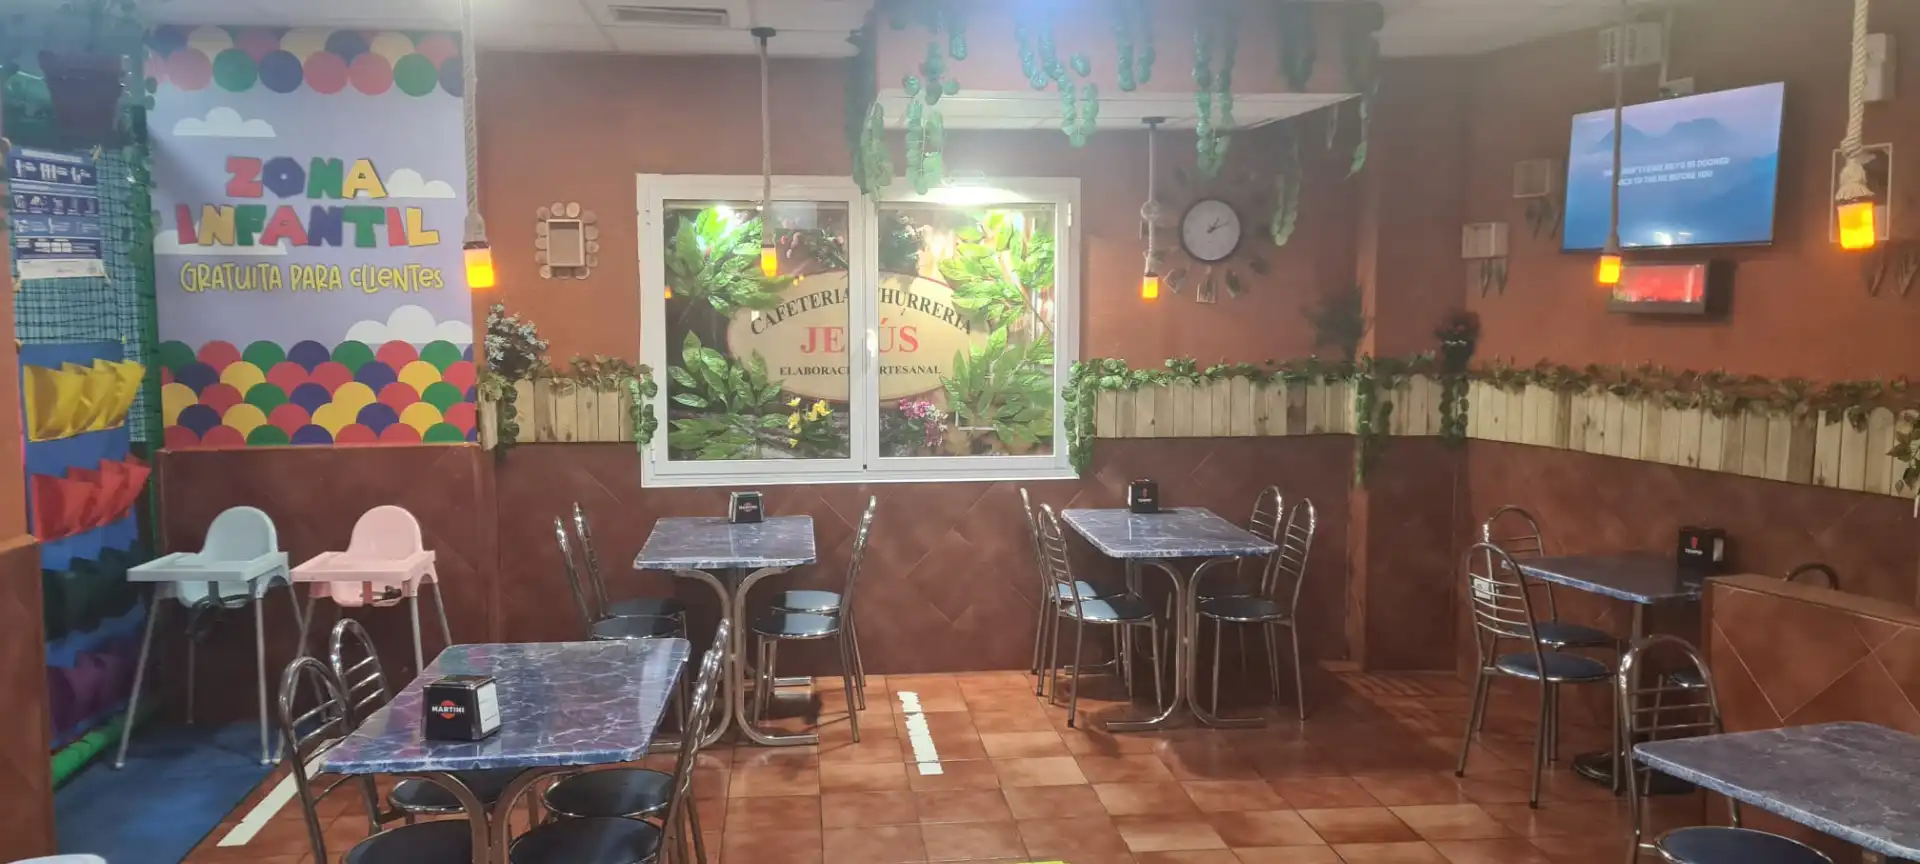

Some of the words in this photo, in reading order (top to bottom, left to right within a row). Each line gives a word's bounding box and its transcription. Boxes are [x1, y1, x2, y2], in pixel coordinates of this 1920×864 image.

[225, 156, 388, 199] ZONA
[175, 203, 440, 248] INFANTIL
[180, 261, 283, 293] GRATUITA
[290, 263, 343, 292] PARA
[879, 287, 971, 335] HURRERIA
[800, 317, 919, 355] JEÚS
[879, 364, 942, 374] RTESANAL
